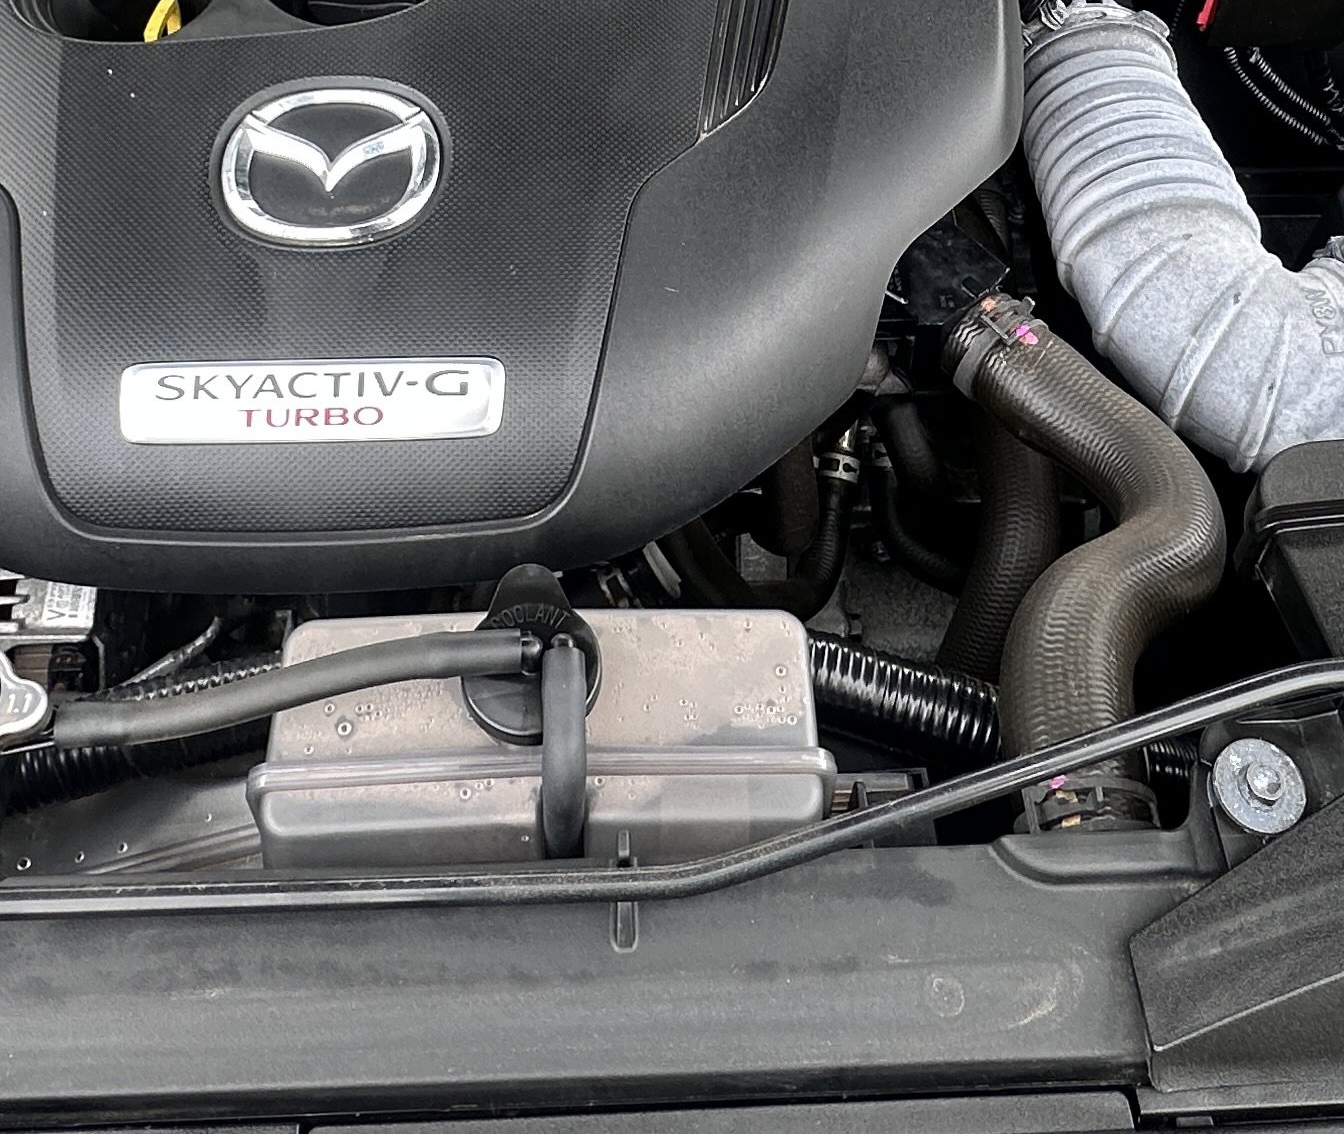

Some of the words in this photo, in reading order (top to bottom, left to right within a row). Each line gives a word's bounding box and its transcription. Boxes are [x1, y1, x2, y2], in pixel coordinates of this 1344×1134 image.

[155, 369, 470, 402] SKYACTIV-G
[238, 406, 385, 429] TURBO
[489, 603, 572, 630] COOLANT
[6, 692, 34, 714] 1.1
